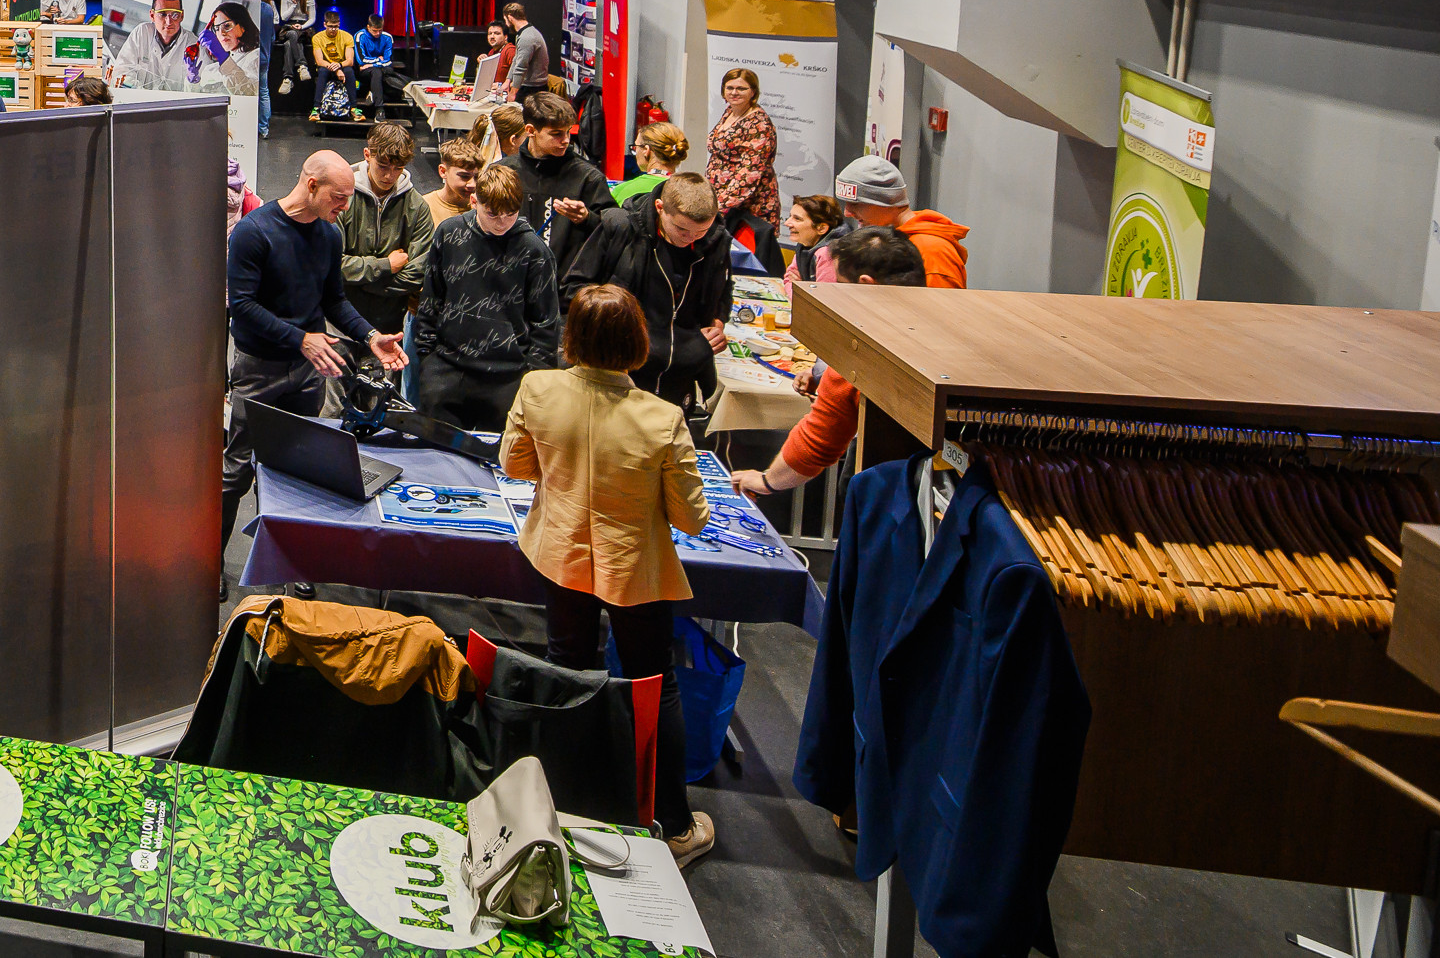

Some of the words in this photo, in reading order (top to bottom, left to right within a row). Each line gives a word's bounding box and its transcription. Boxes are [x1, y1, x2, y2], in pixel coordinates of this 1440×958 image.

[946, 446, 963, 465] 305
[143, 797, 157, 814] US!
[140, 814, 155, 850] FOLLOW
[388, 831, 455, 933] klub
